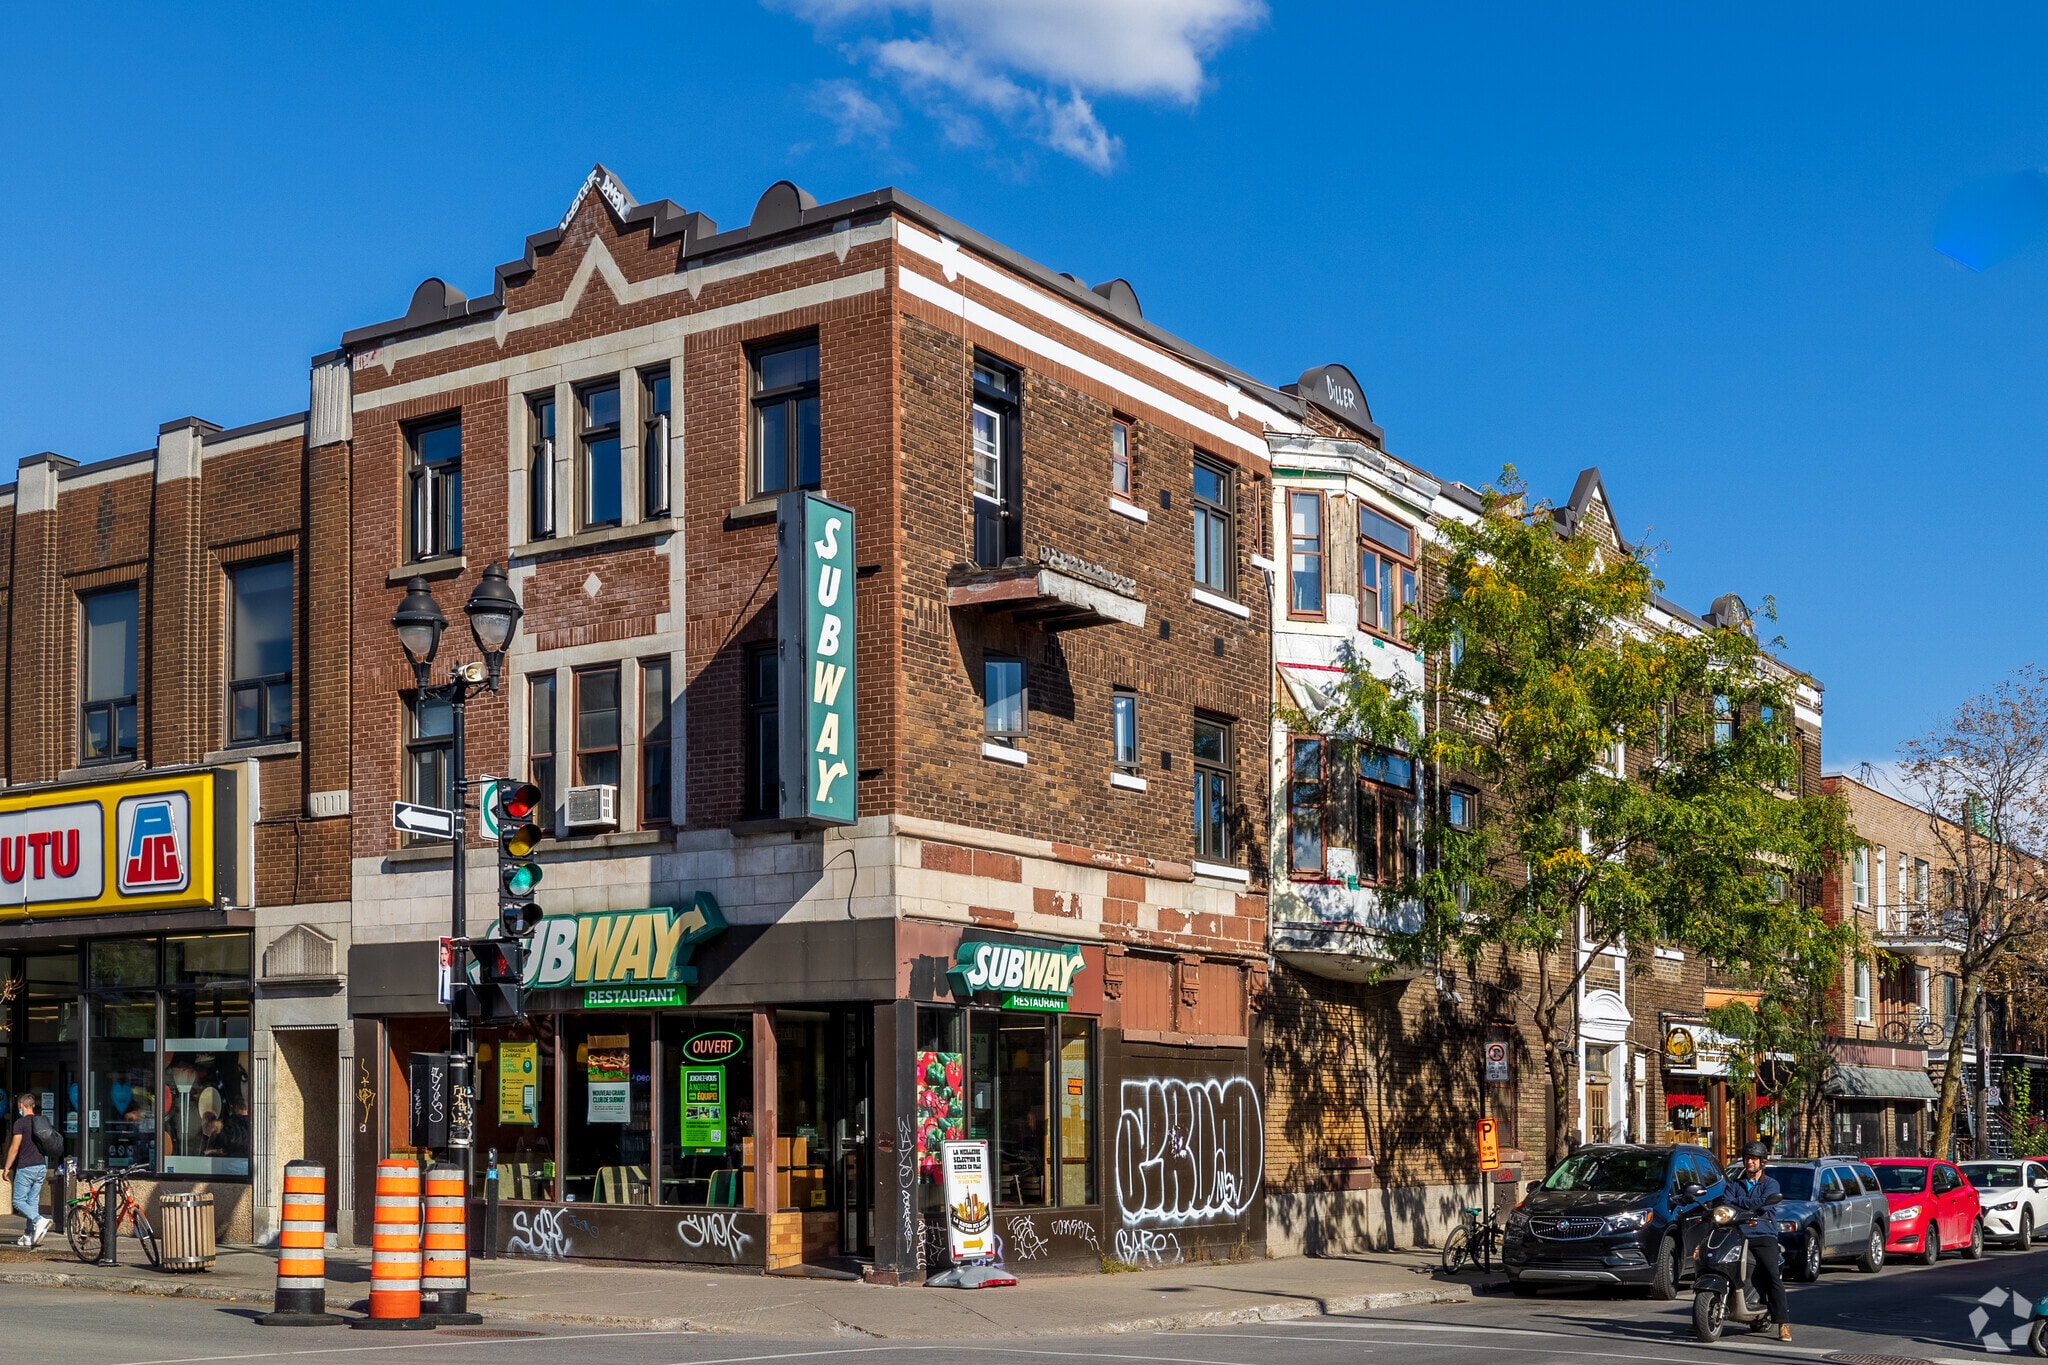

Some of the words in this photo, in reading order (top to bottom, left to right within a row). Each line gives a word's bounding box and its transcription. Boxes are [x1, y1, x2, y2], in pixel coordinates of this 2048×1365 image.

[813, 517, 848, 802] SUBWAY
[0, 828, 80, 884] UTU
[468, 904, 707, 986] UBWAY
[967, 944, 1085, 993] SUBWAY
[588, 988, 676, 1005] RESTAURANT
[1013, 995, 1064, 1009] RESTAURANT
[692, 1040, 734, 1053] OUVERT
[1482, 1122, 1492, 1141] P
